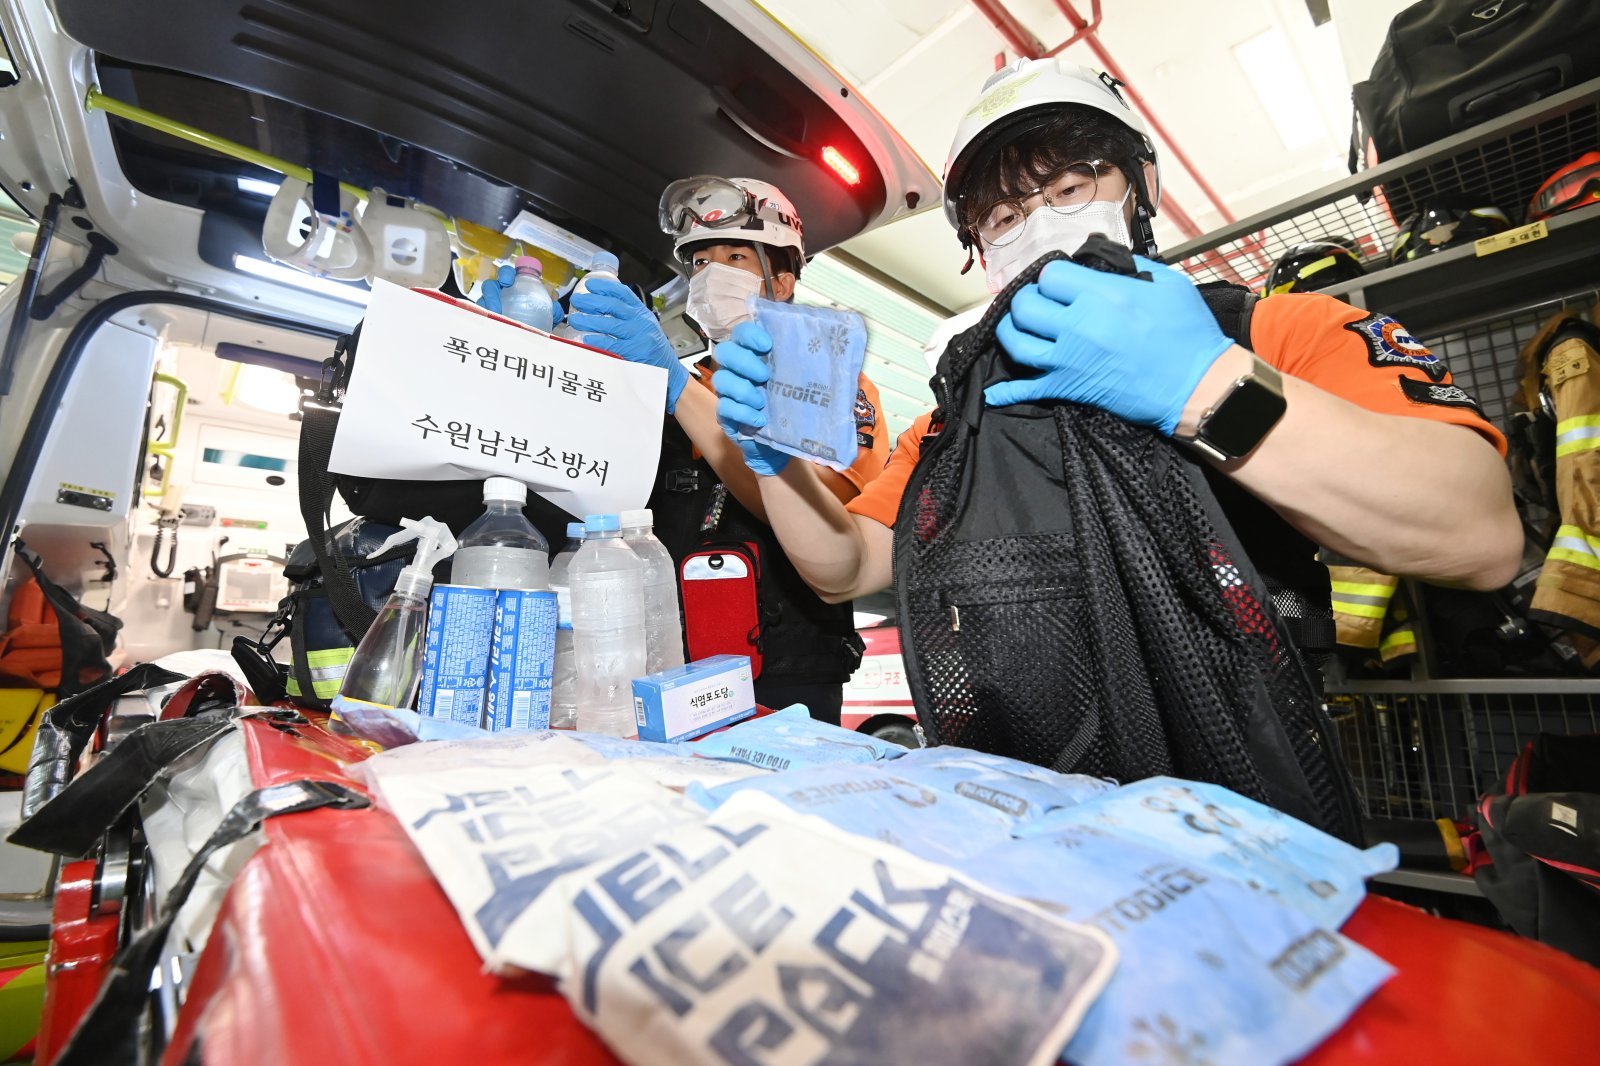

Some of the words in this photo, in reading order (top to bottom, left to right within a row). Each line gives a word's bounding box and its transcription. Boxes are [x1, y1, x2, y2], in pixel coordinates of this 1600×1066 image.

[442, 336, 608, 403] 폭염대비물품
[411, 414, 610, 486] 수원남부소방서
[690, 686, 729, 708] 식염포도당
[751, 751, 767, 764] ICE
[572, 824, 770, 1016] JELL
[628, 872, 796, 1019] ICE
[706, 858, 950, 1066] PACK
